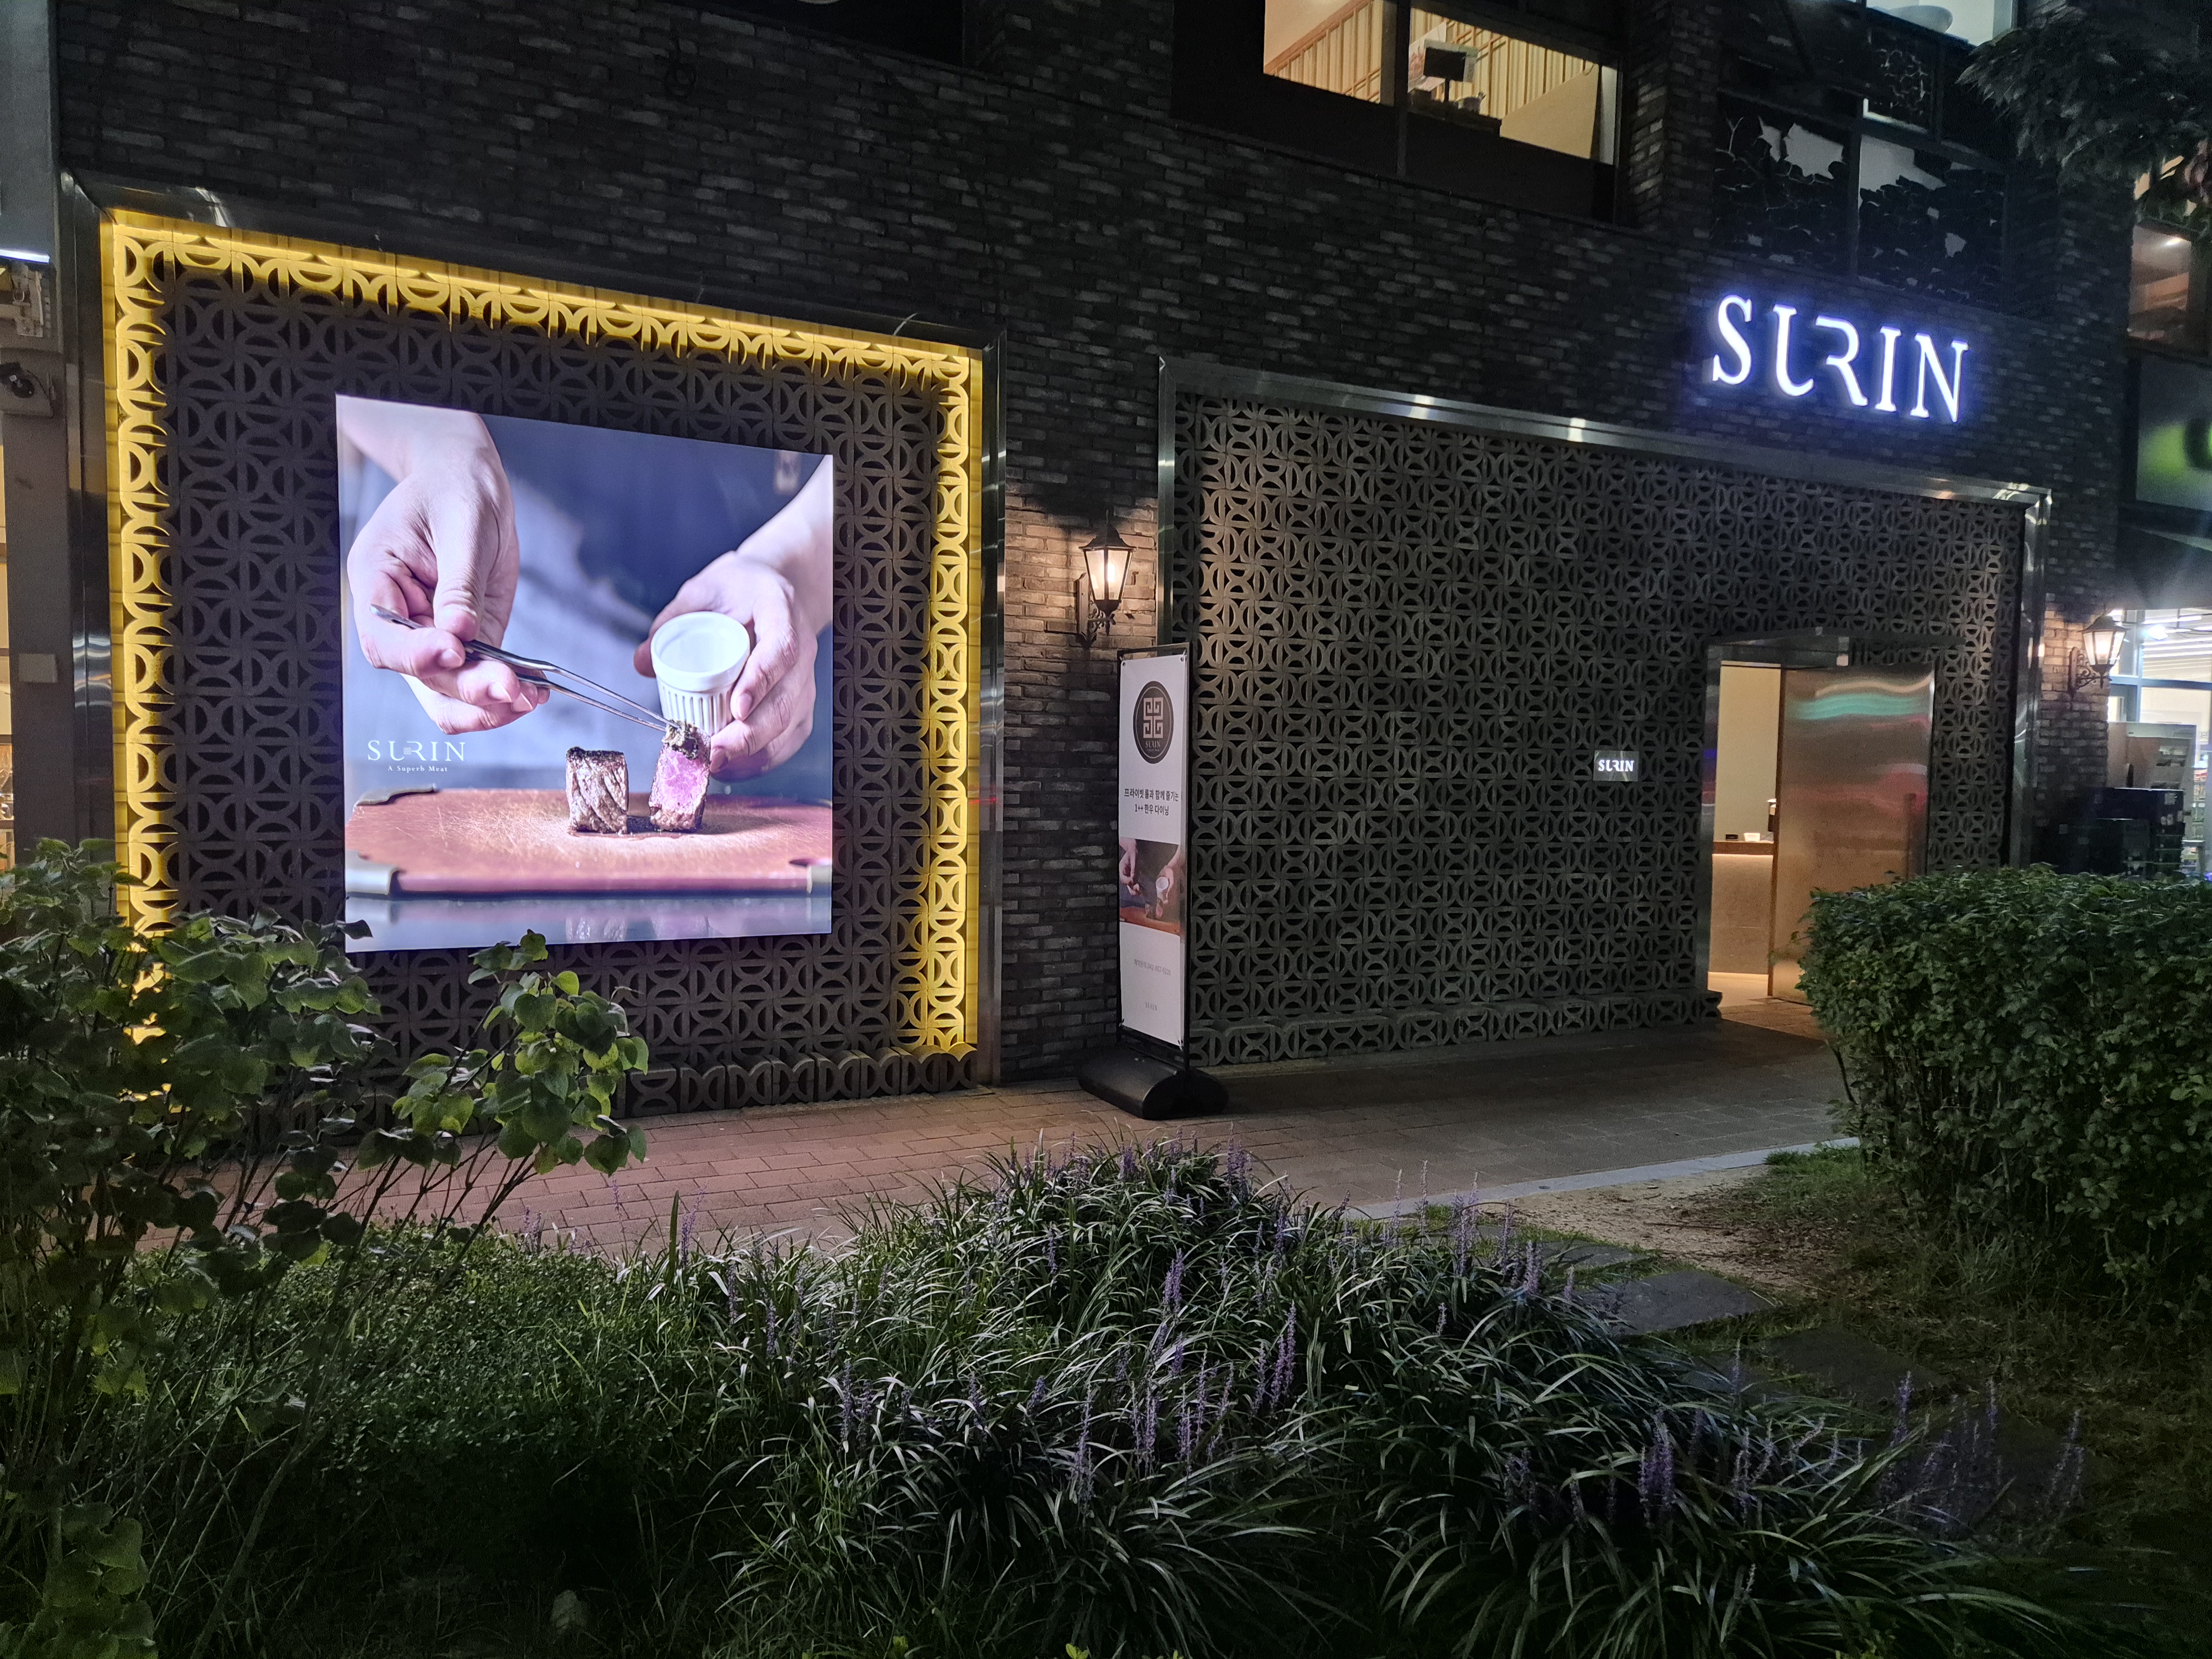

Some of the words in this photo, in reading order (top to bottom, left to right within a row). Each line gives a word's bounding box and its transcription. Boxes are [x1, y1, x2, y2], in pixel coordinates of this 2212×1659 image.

[1712, 294, 1969, 422] SURIN
[368, 740, 466, 761] SURIN
[1145, 740, 1161, 748] SURIN
[1598, 759, 1635, 772] SURIN
[1124, 788, 1144, 799] 프라이빗
[1145, 789, 1154, 800] 룸과
[1155, 790, 1165, 801] 함께
[1166, 791, 1178, 802] 즐기는
[1135, 804, 1143, 812] 1++
[1144, 804, 1153, 815] 한우
[1155, 805, 1169, 816] 다이닝
